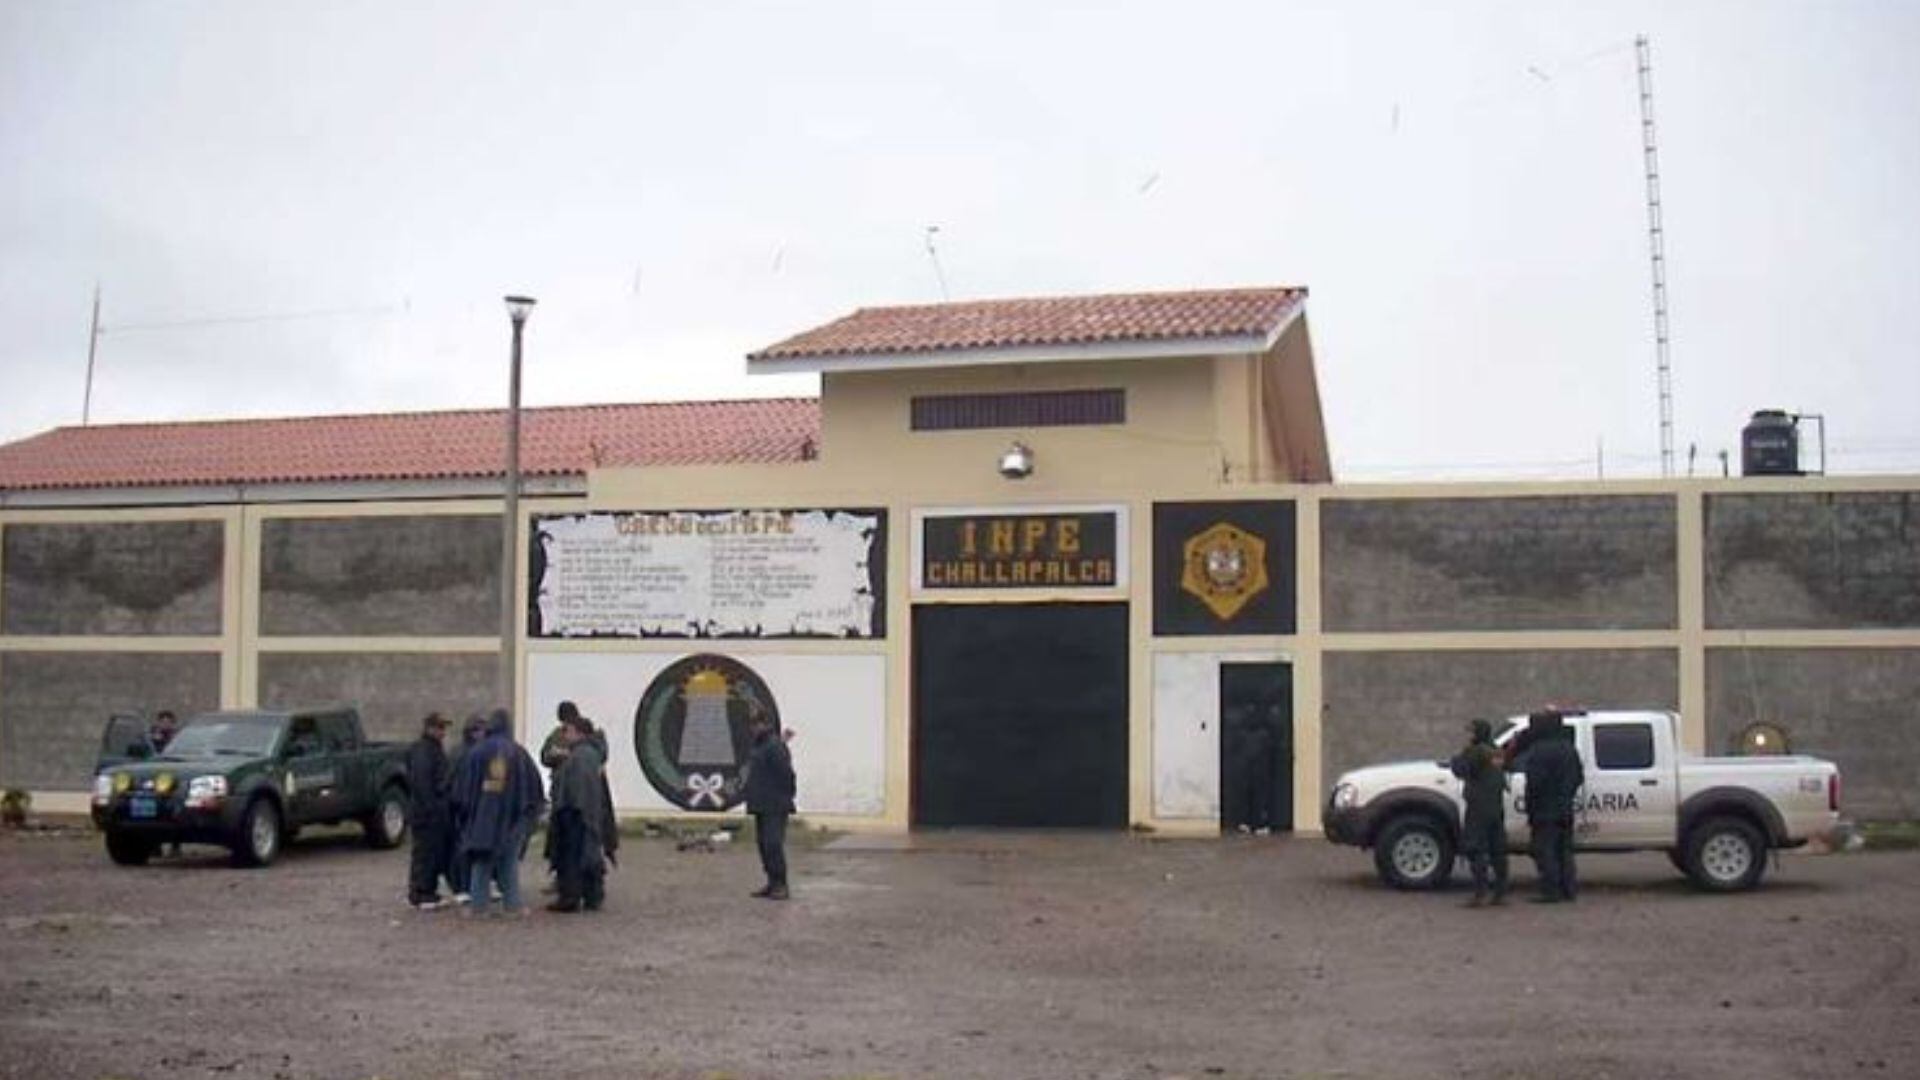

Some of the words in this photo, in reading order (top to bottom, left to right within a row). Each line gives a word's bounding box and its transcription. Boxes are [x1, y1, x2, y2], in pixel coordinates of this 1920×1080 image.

[962, 519, 1081, 553] INPE
[928, 560, 1112, 584] CHALLAPALCA
[1513, 792, 1640, 815] CSARIA
